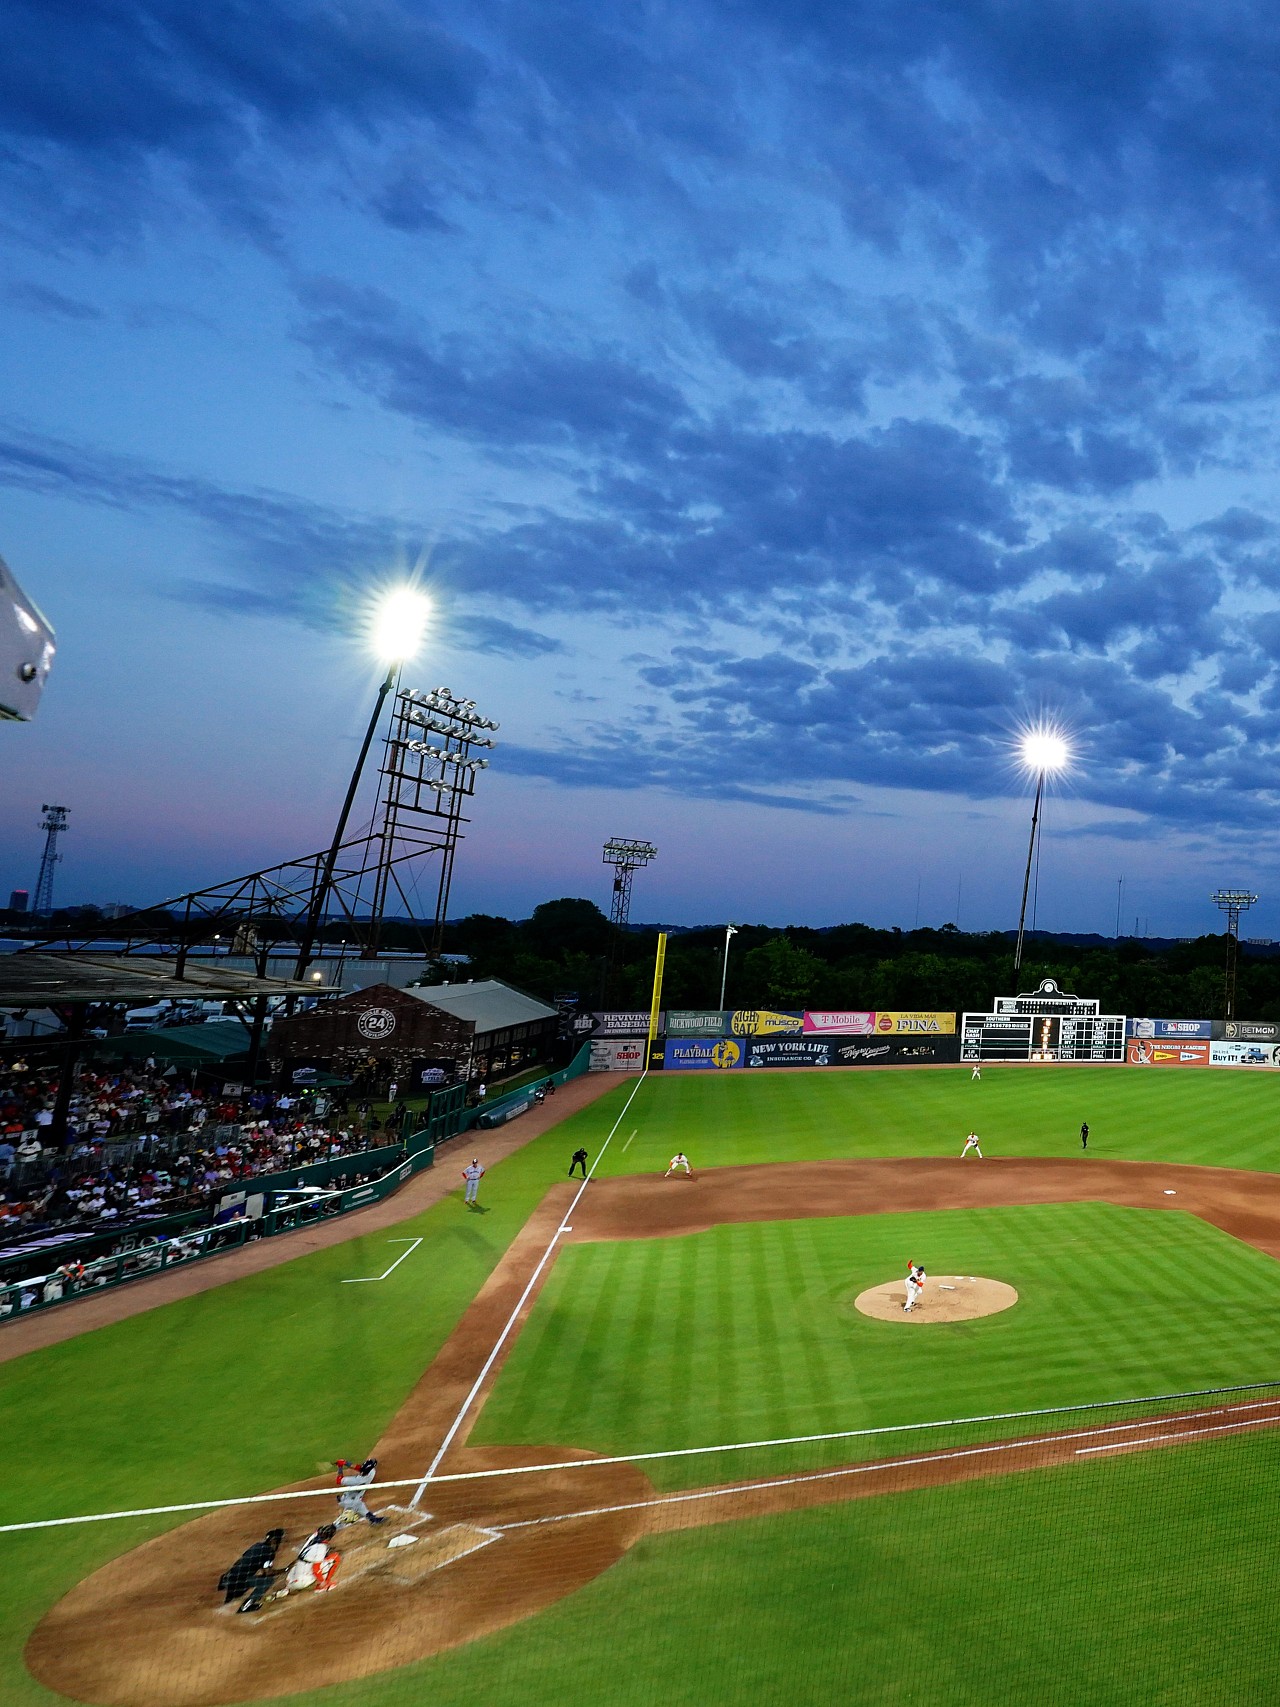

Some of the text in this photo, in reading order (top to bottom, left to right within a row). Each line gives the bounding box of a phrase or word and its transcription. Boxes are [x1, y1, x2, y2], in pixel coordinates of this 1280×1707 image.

[734, 1011, 760, 1022] NIGHT
[831, 1016, 860, 1024] Mobile
[368, 1018, 386, 1029] 24
[574, 1020, 594, 1029] RBI
[670, 1017, 722, 1028] RICKWOOD FIELD
[896, 1020, 940, 1032] FINA
[1178, 1023, 1200, 1032] SHOP
[734, 1023, 759, 1035] BALL
[752, 1042, 829, 1054] NEW YORK LIFE
